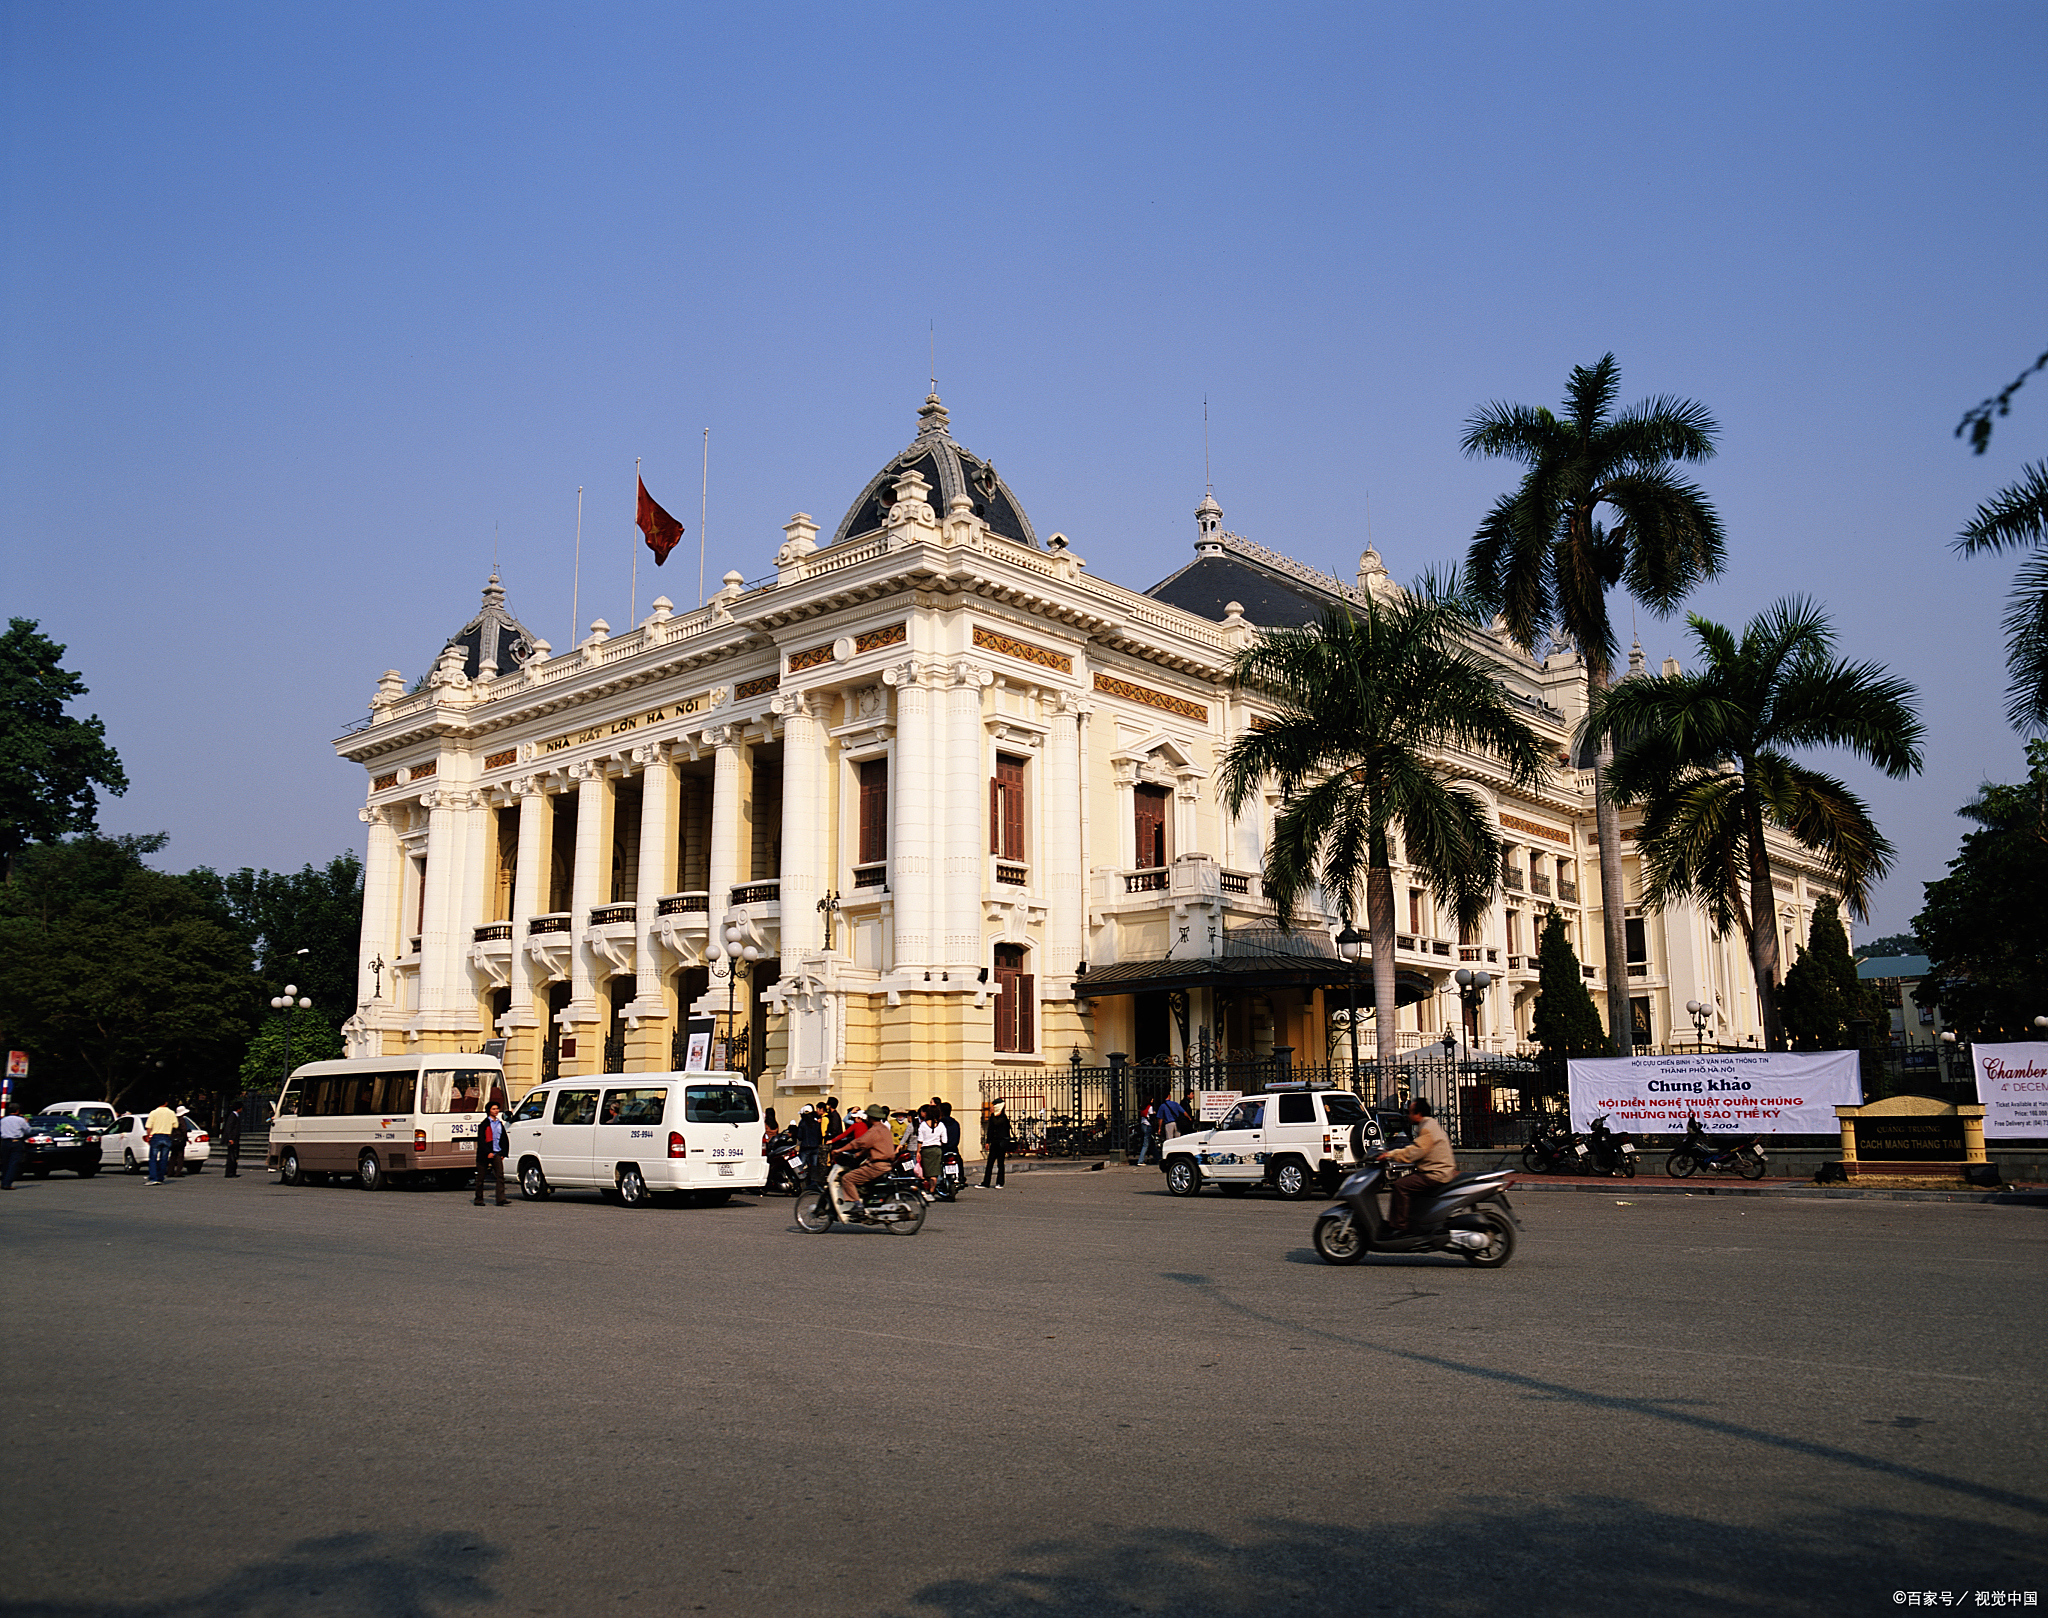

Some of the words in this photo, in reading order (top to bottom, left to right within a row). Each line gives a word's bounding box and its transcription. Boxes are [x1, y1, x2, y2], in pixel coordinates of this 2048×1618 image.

[546, 735, 571, 753] NHÀ
[578, 727, 603, 744] HÁT
[611, 717, 637, 735] LỚN
[647, 708, 665, 724] HÀ
[1660, 1066, 1687, 1074] THÀNH
[1707, 1065, 1719, 1073] HÀ
[1982, 1057, 2048, 1082] Chamber
[1648, 1080, 1703, 1094] Chung
[1707, 1076, 1752, 1091] khảo
[1599, 1098, 1618, 1109] HỘI
[1621, 1096, 1646, 1107] DIỄN
[1649, 1097, 1682, 1109] NGHỆ
[1684, 1096, 1720, 1108] THUẬT
[1723, 1094, 1758, 1107] QUẦN
[1760, 1096, 1803, 1106] CHÚNG
[1703, 1110, 1731, 1119] SAO
[1734, 1106, 1760, 1119] THẾ
[1763, 1107, 1781, 1118] KỶ
[451, 1124, 464, 1134] 29S
[1668, 1121, 1684, 1129] HÀ
[630, 1130, 654, 1139] 29S-9944
